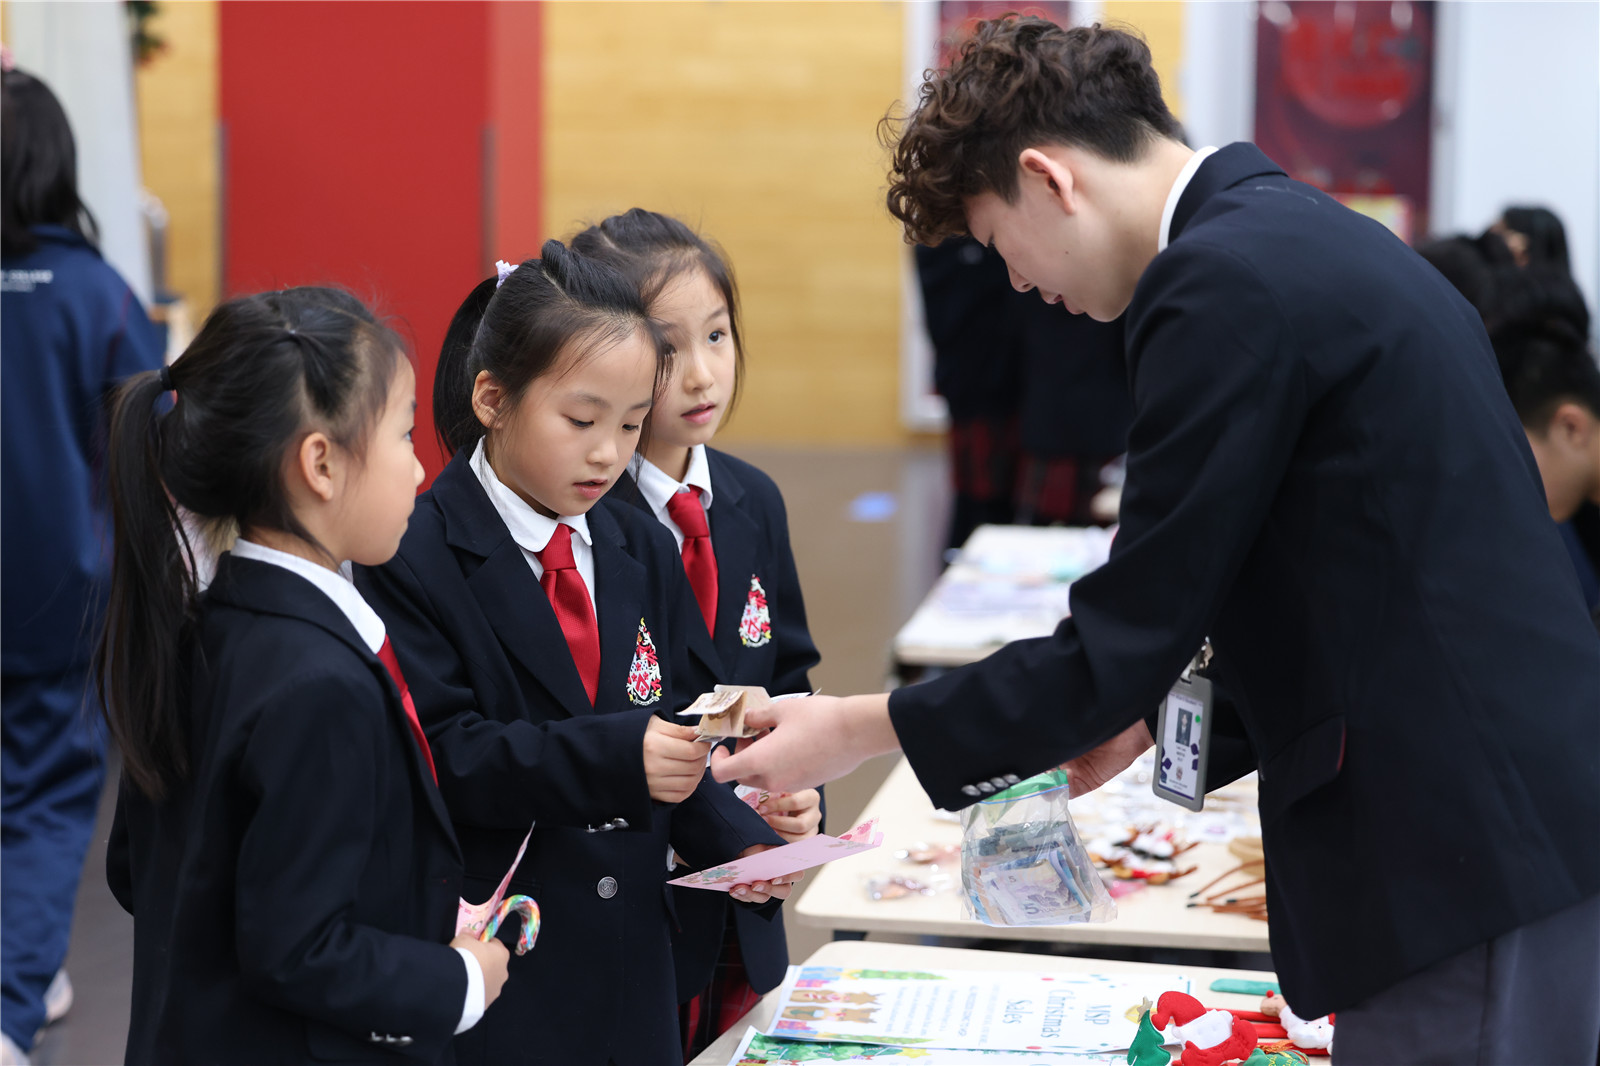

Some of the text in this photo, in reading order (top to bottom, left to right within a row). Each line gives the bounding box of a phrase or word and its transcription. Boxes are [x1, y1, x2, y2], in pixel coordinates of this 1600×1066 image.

[1023, 902, 1040, 915] 5
[1002, 999, 1034, 1025] Sales
[1040, 989, 1077, 1038] Christmas
[1085, 1004, 1112, 1026] MSP
